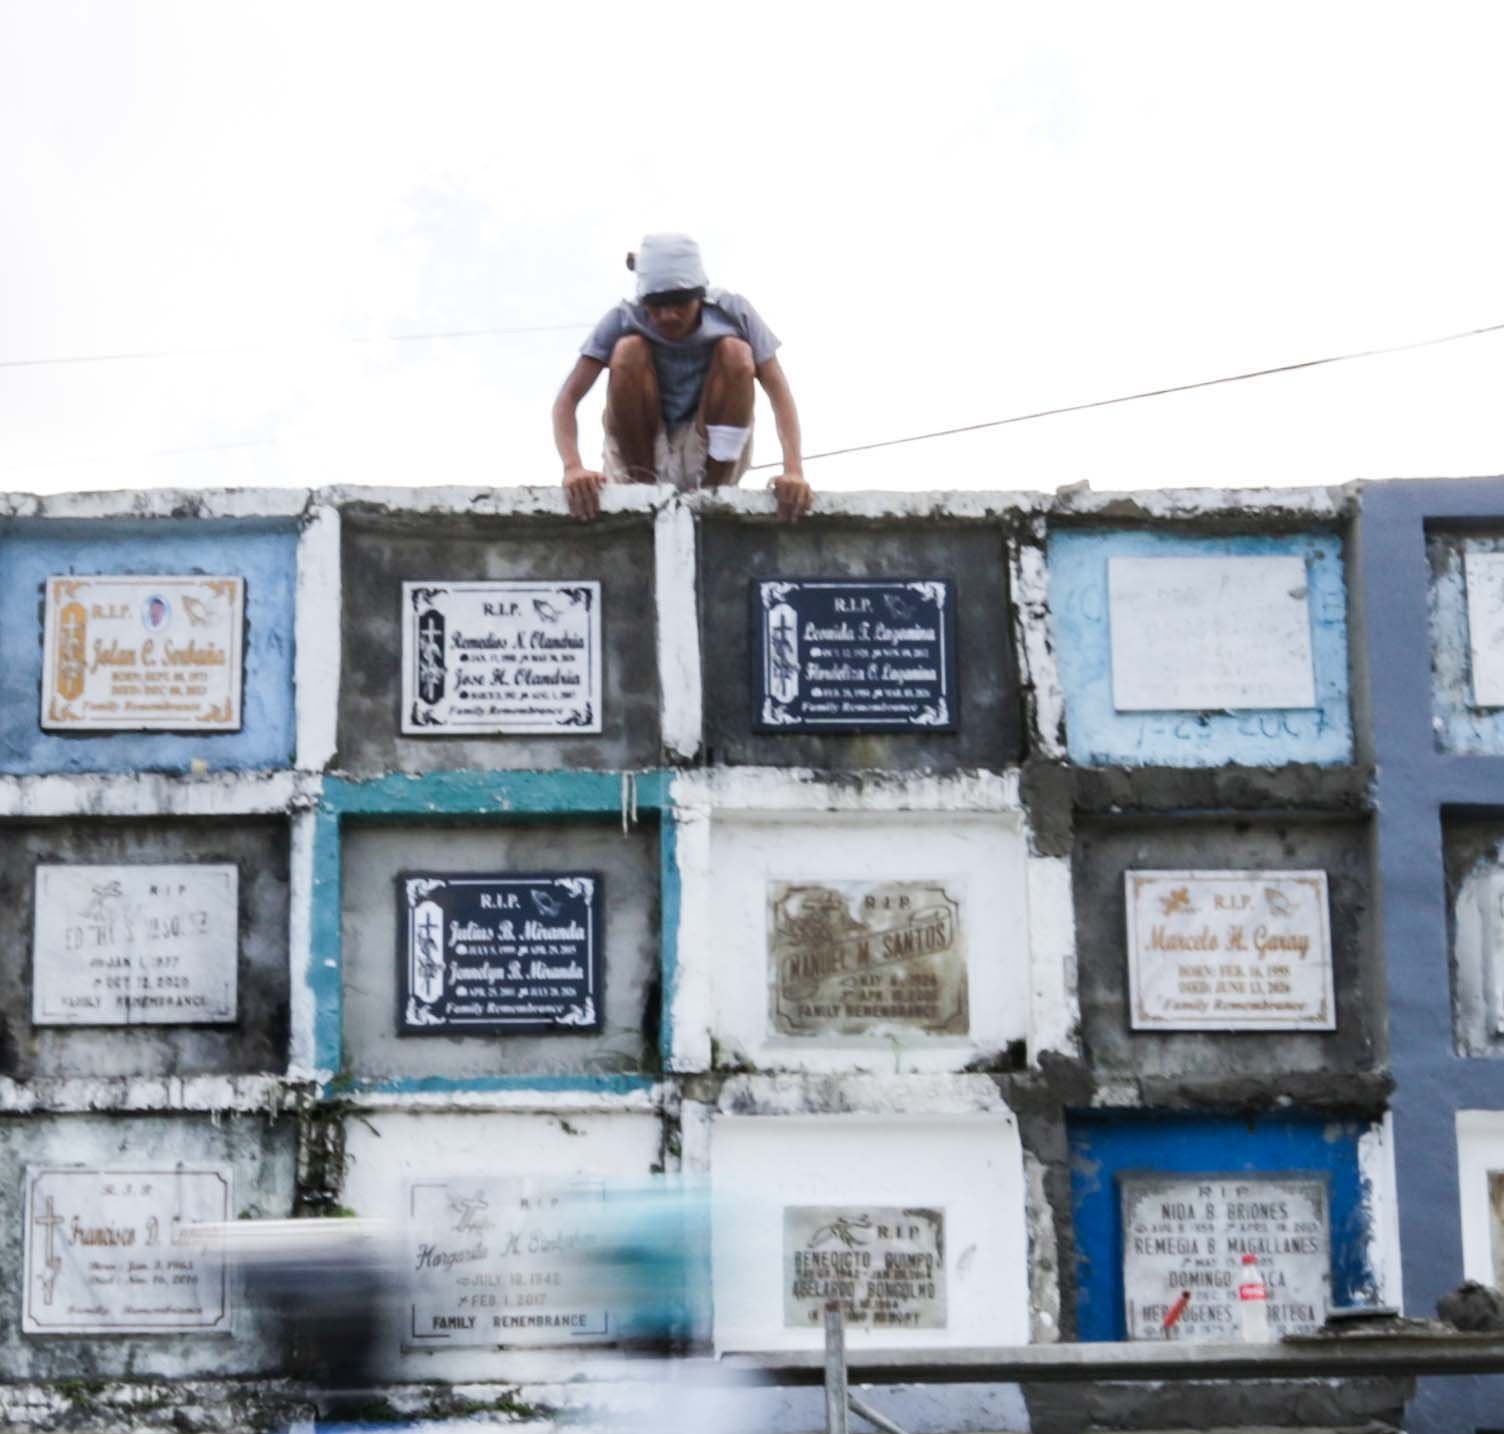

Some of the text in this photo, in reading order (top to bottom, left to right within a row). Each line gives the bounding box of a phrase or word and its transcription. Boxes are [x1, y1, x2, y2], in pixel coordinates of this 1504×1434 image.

[483, 603, 522, 616] R.I.P.
[834, 598, 875, 613] R.I.P.
[480, 893, 522, 909] R.I.P.
[1213, 895, 1255, 911] R.I.P.
[519, 920, 587, 942] Miranda
[883, 922, 947, 959] SANTOS
[526, 960, 585, 981] Miranda
[1160, 1203, 1194, 1220] NIDA
[1226, 1202, 1289, 1219] BRIONES
[1132, 1238, 1198, 1255] REMEGIA
[1227, 1238, 1319, 1255] MAGALLANES
[1168, 1272, 1232, 1288] DOMINGO
[433, 1313, 588, 1329] FAMILY REMEMBRANCE
